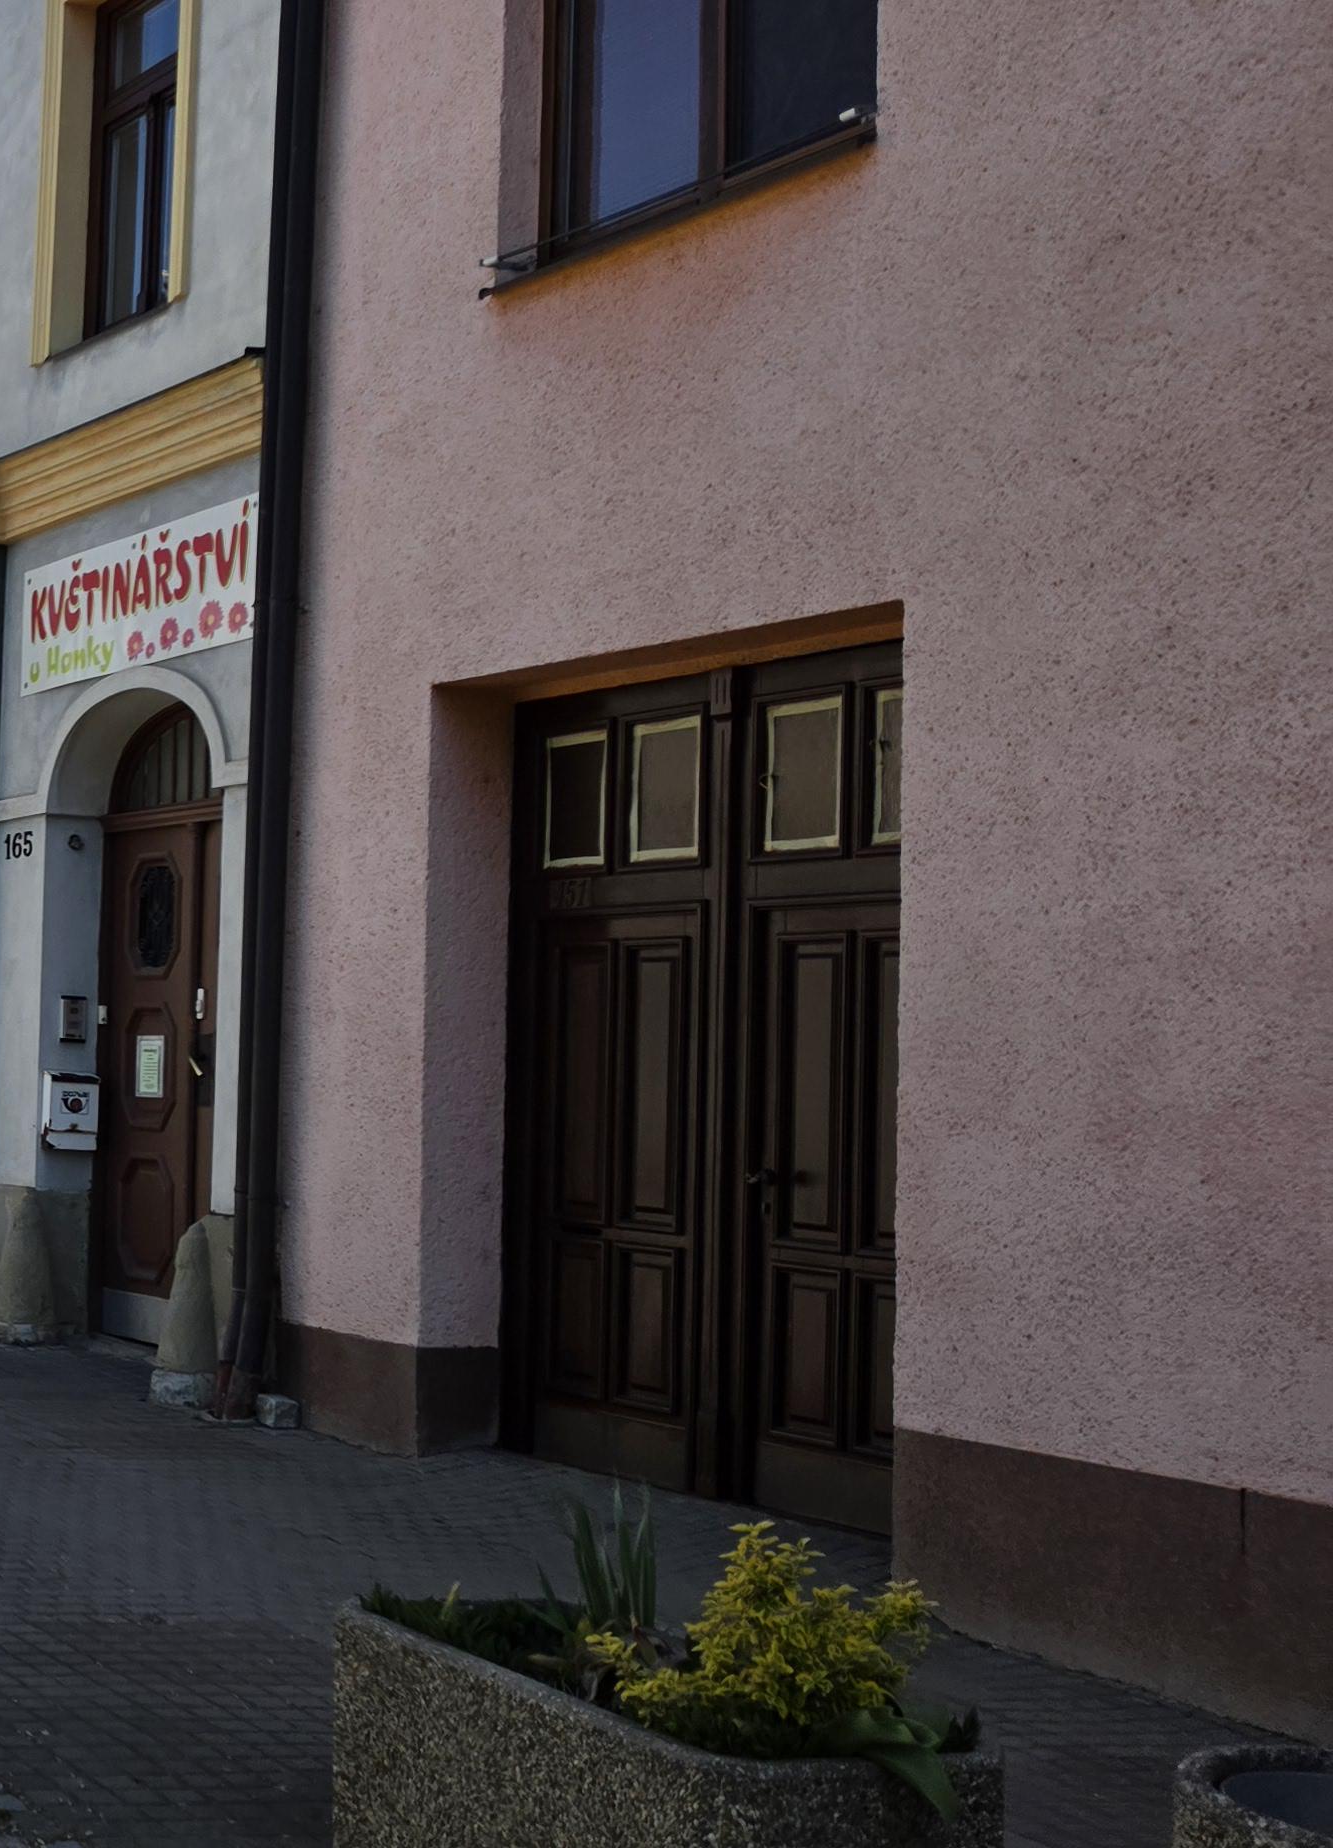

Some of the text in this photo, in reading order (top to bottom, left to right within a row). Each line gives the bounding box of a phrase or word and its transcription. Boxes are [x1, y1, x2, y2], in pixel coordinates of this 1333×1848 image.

[30, 498, 250, 644] KVĚTINÁŘSTVÍ
[47, 635, 115, 678] Hanky
[4, 830, 34, 860] 165
